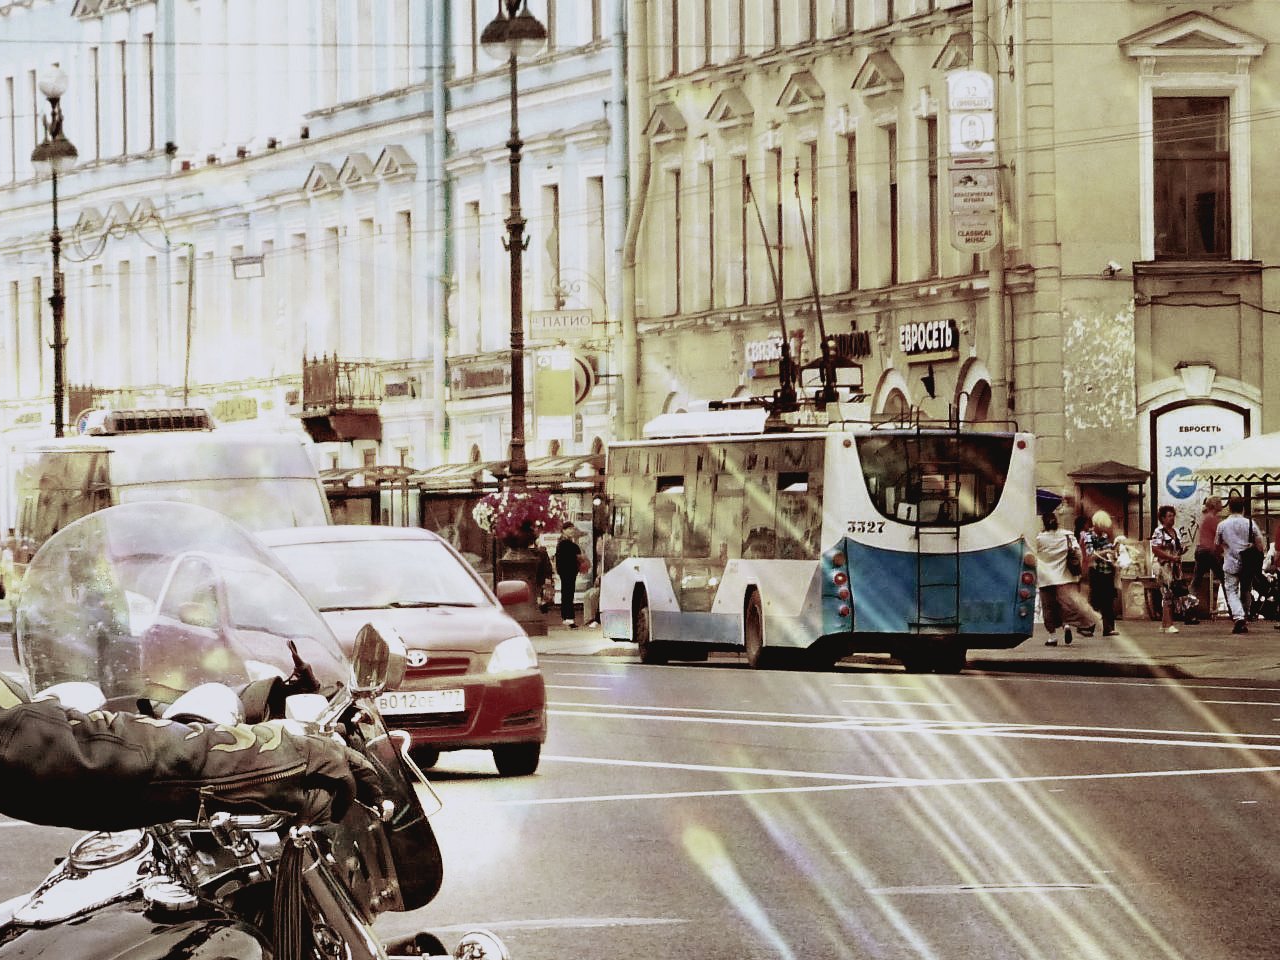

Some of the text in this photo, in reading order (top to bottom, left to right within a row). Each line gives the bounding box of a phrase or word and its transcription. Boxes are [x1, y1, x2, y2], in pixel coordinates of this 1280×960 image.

[957, 229, 992, 237] CLASSICAL
[964, 236, 987, 244] MUSIC
[542, 315, 591, 328] ПАТИО
[899, 319, 954, 353] ЕВРОСЕТЬ
[1178, 425, 1222, 433] ЕВРОСЕТЬ
[847, 520, 886, 534] 3327
